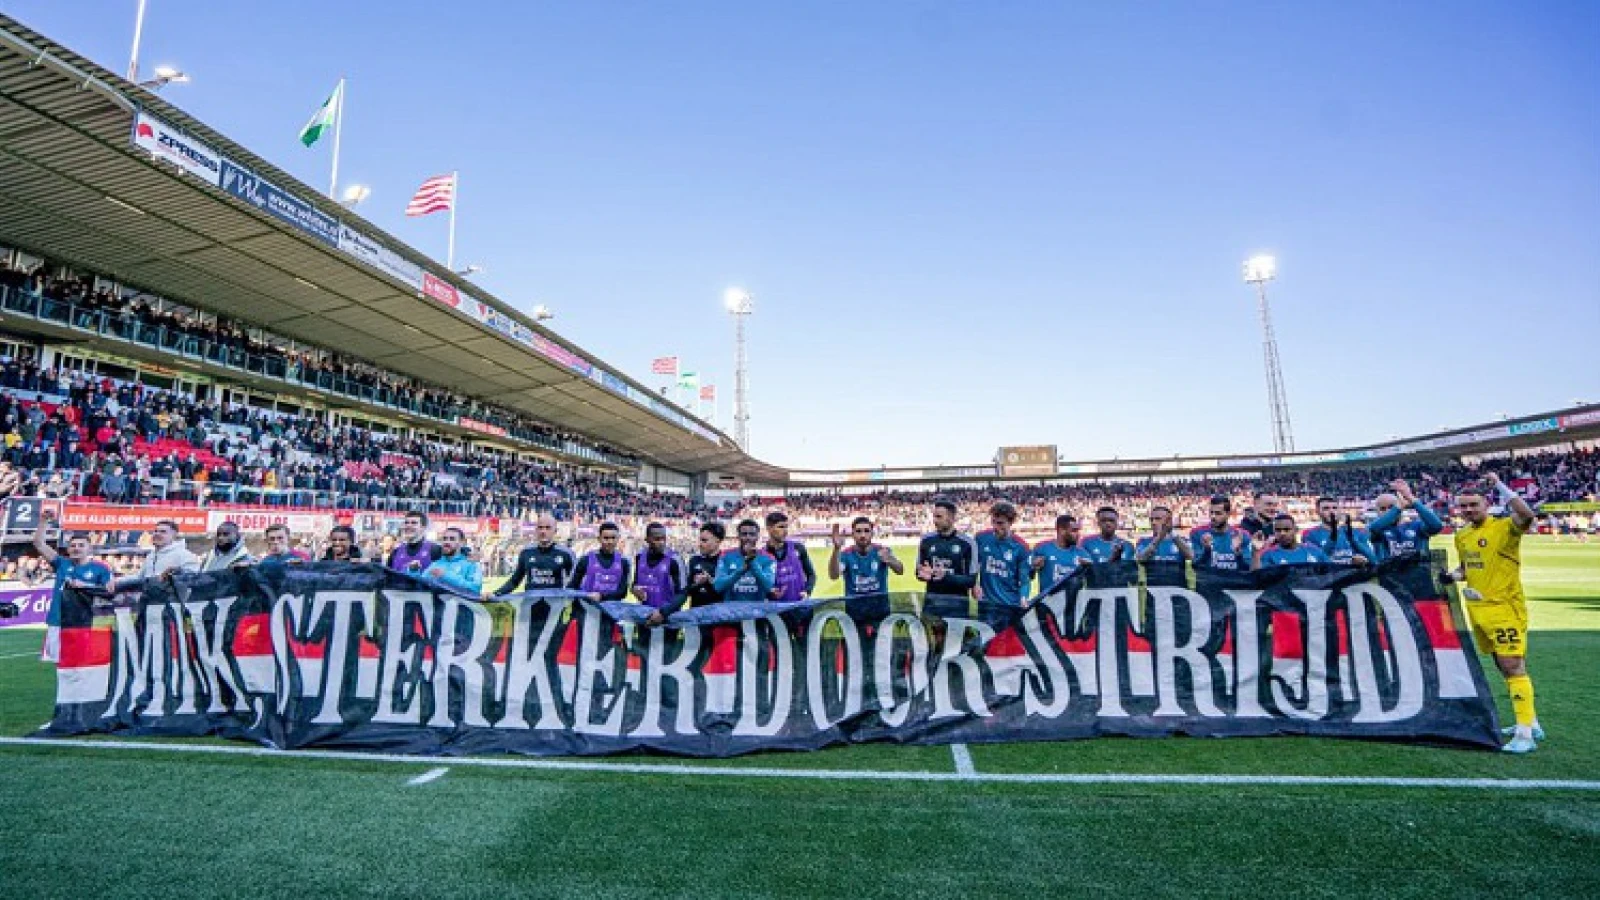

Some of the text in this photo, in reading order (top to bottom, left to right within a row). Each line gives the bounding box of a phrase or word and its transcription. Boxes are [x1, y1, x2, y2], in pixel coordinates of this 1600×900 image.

[15, 504, 32, 523] 2
[89, 514, 116, 525] ALLES
[1495, 627, 1521, 644] 22
[271, 590, 701, 737] STERKER
[732, 611, 995, 736] DOOR
[1022, 583, 1424, 724] STRIJD
